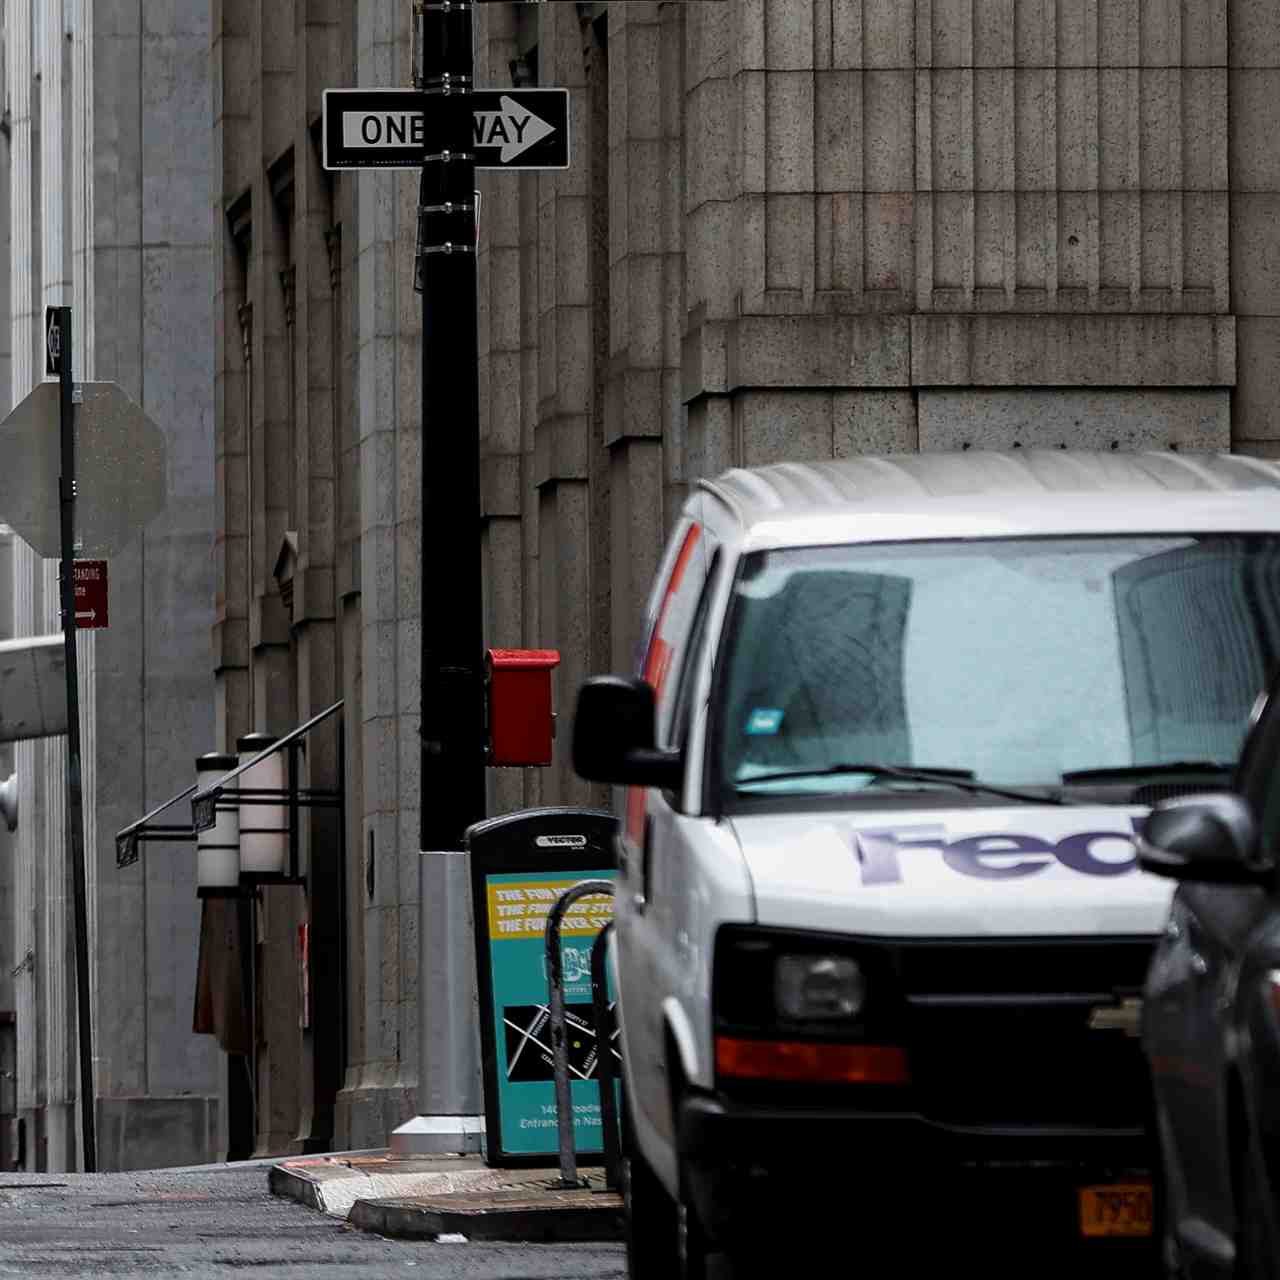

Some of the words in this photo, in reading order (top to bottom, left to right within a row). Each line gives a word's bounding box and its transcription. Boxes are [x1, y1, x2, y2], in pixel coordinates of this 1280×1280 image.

[361, 115, 424, 145] ONE
[851, 816, 1149, 886] Fed
[520, 1117, 559, 1129] Entranc
